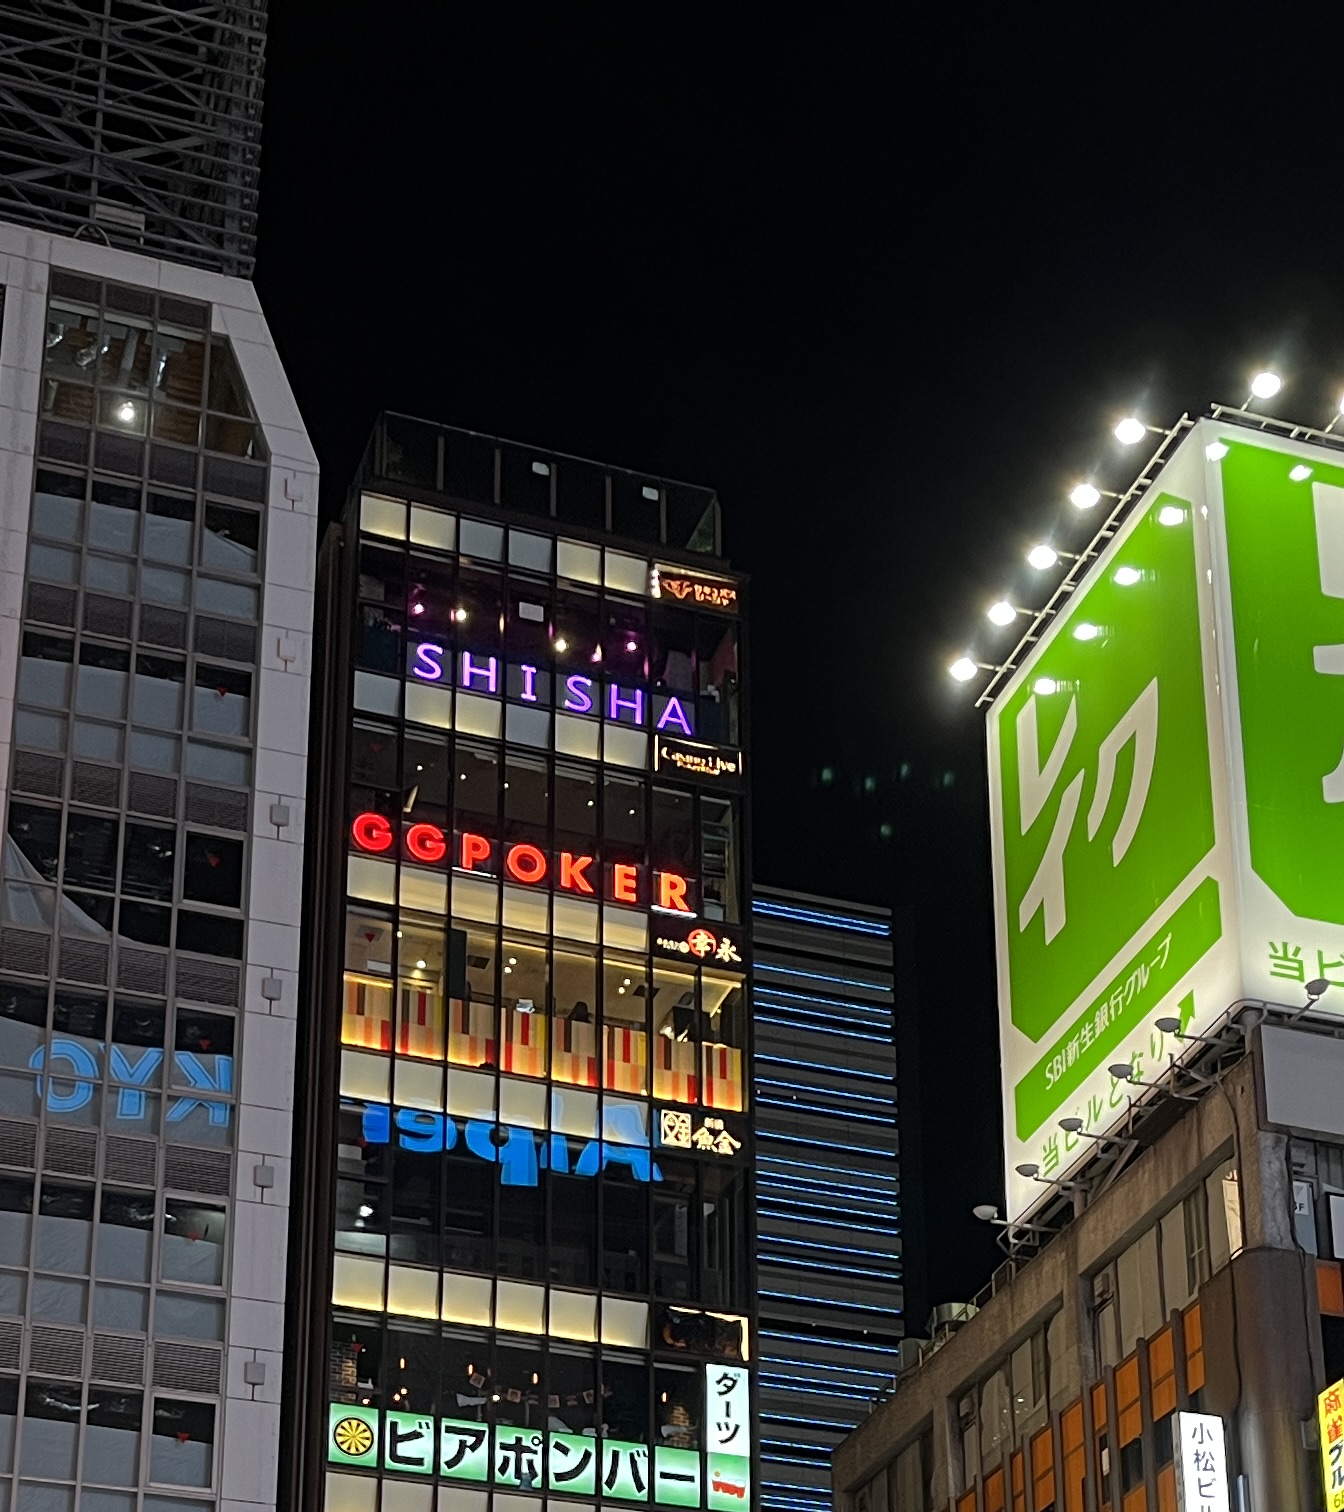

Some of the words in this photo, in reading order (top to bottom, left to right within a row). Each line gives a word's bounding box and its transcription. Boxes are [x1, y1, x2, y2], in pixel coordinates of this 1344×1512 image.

[412, 642, 694, 736] SHISHA
[1016, 675, 1160, 947] レイク
[352, 811, 691, 912] GGPOKER
[1043, 934, 1175, 1092] SBI新生銀行グループ
[388, 1418, 697, 1495] ビアポンバー
[714, 1371, 741, 1445] ダーツ
